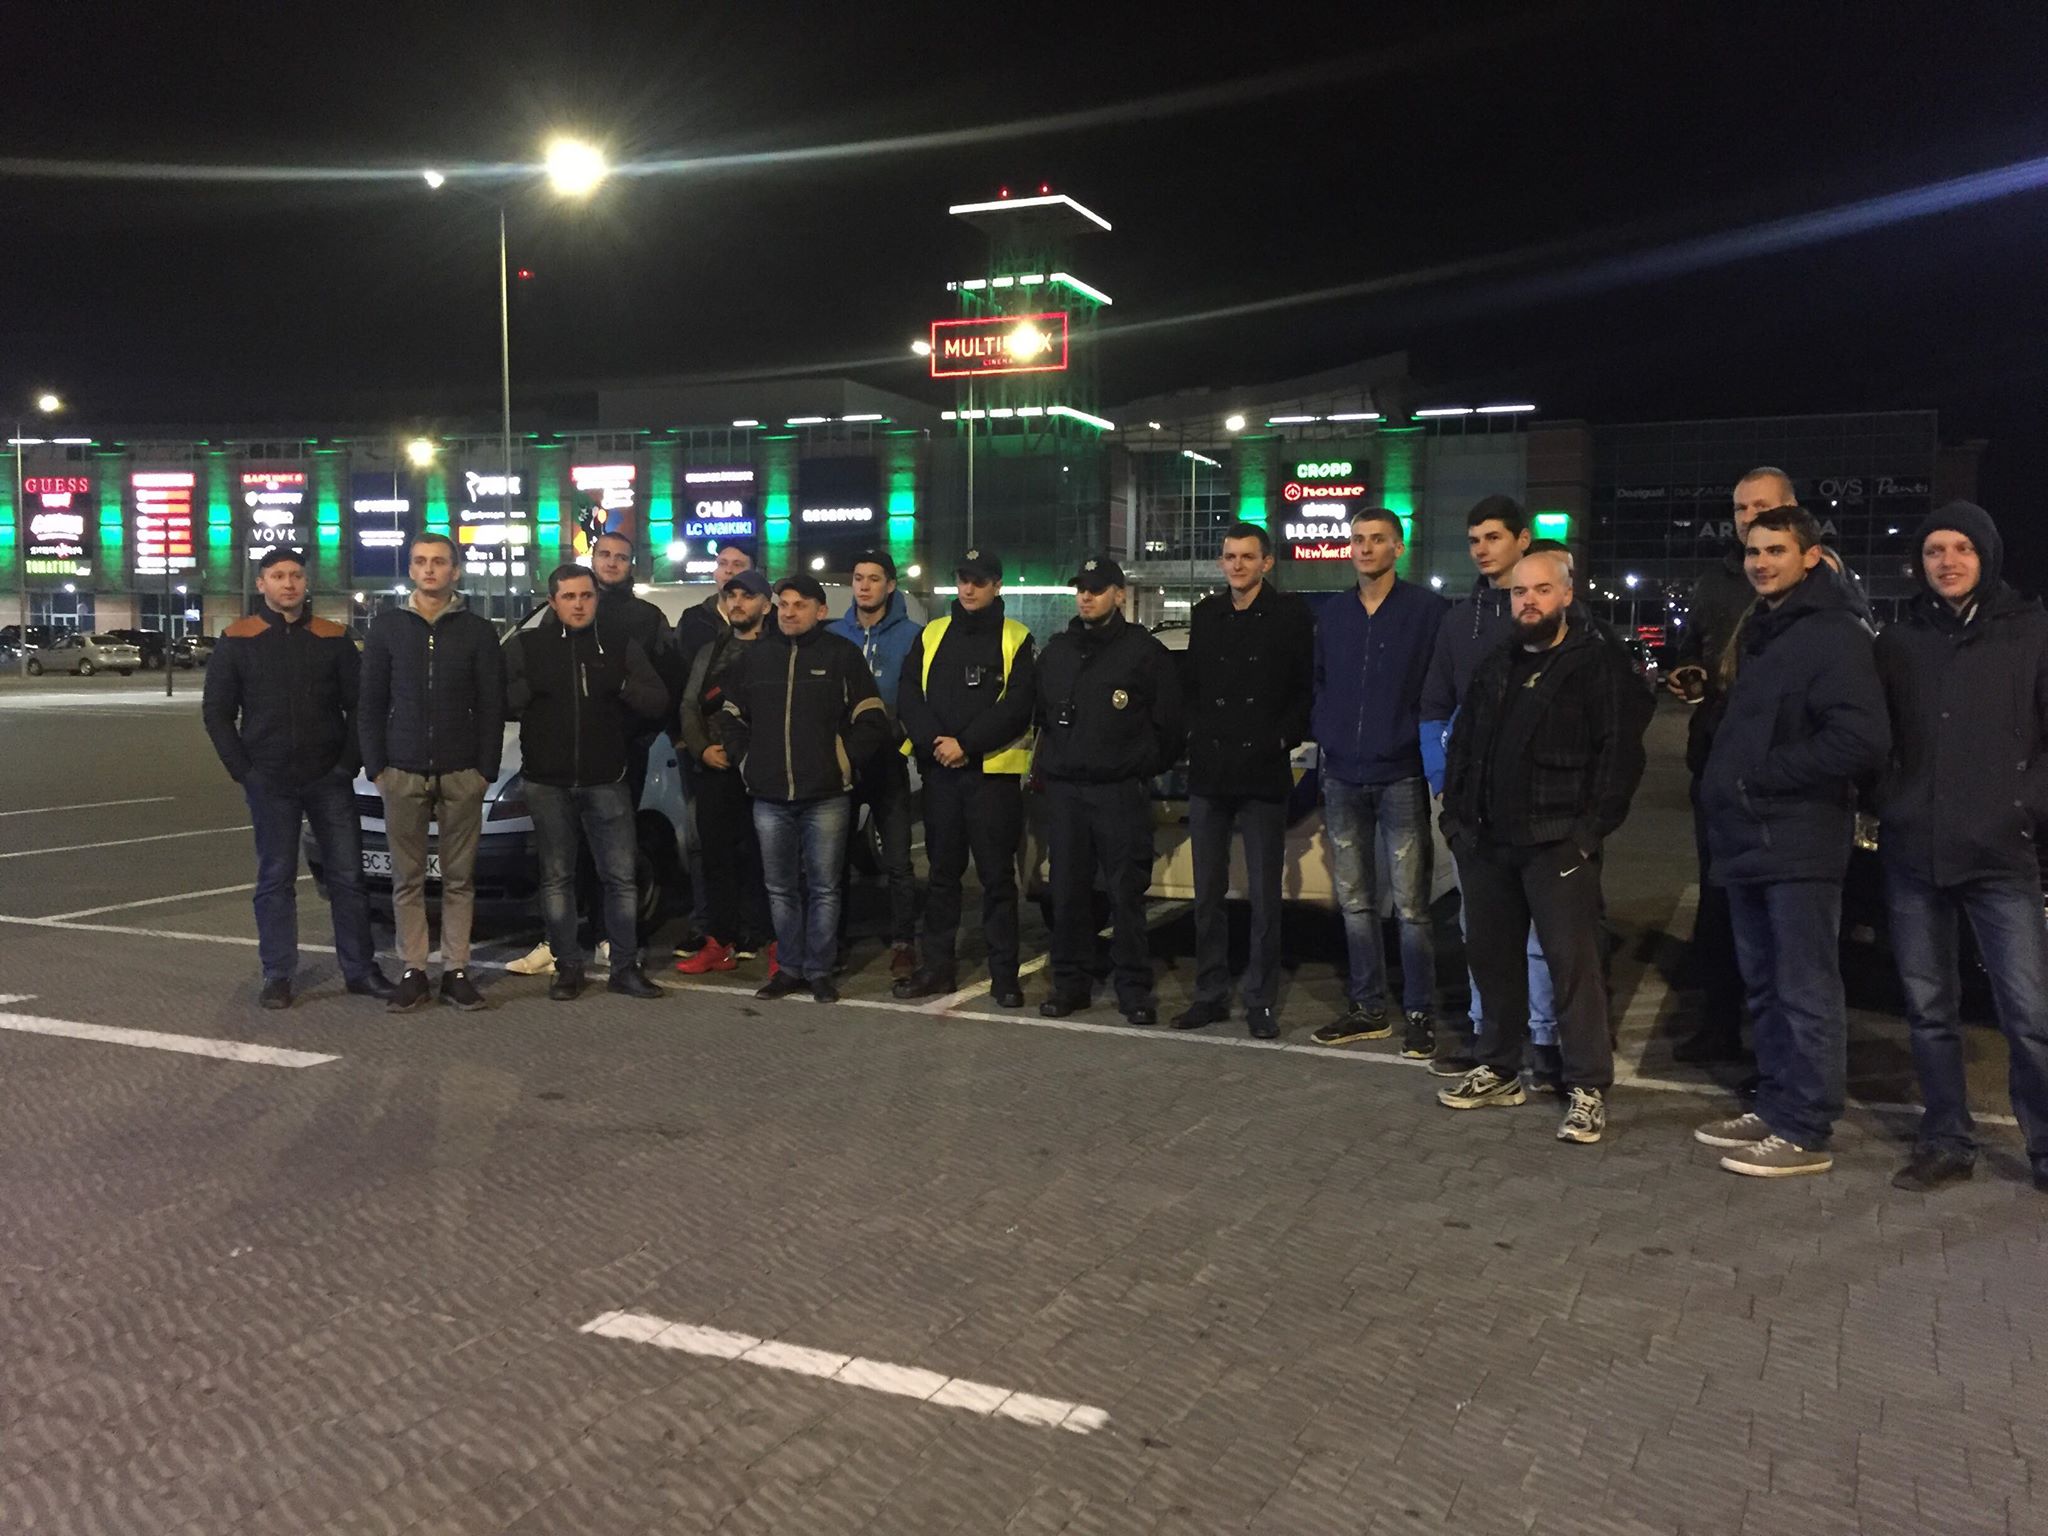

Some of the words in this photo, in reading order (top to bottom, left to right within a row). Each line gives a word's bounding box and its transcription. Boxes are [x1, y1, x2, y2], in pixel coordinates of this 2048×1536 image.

[1297, 462, 1352, 478] CROPP
[25, 477, 88, 494] GUESS
[1302, 486, 1365, 498] house
[1818, 479, 1863, 497] OVS
[252, 528, 297, 542] VOVK
